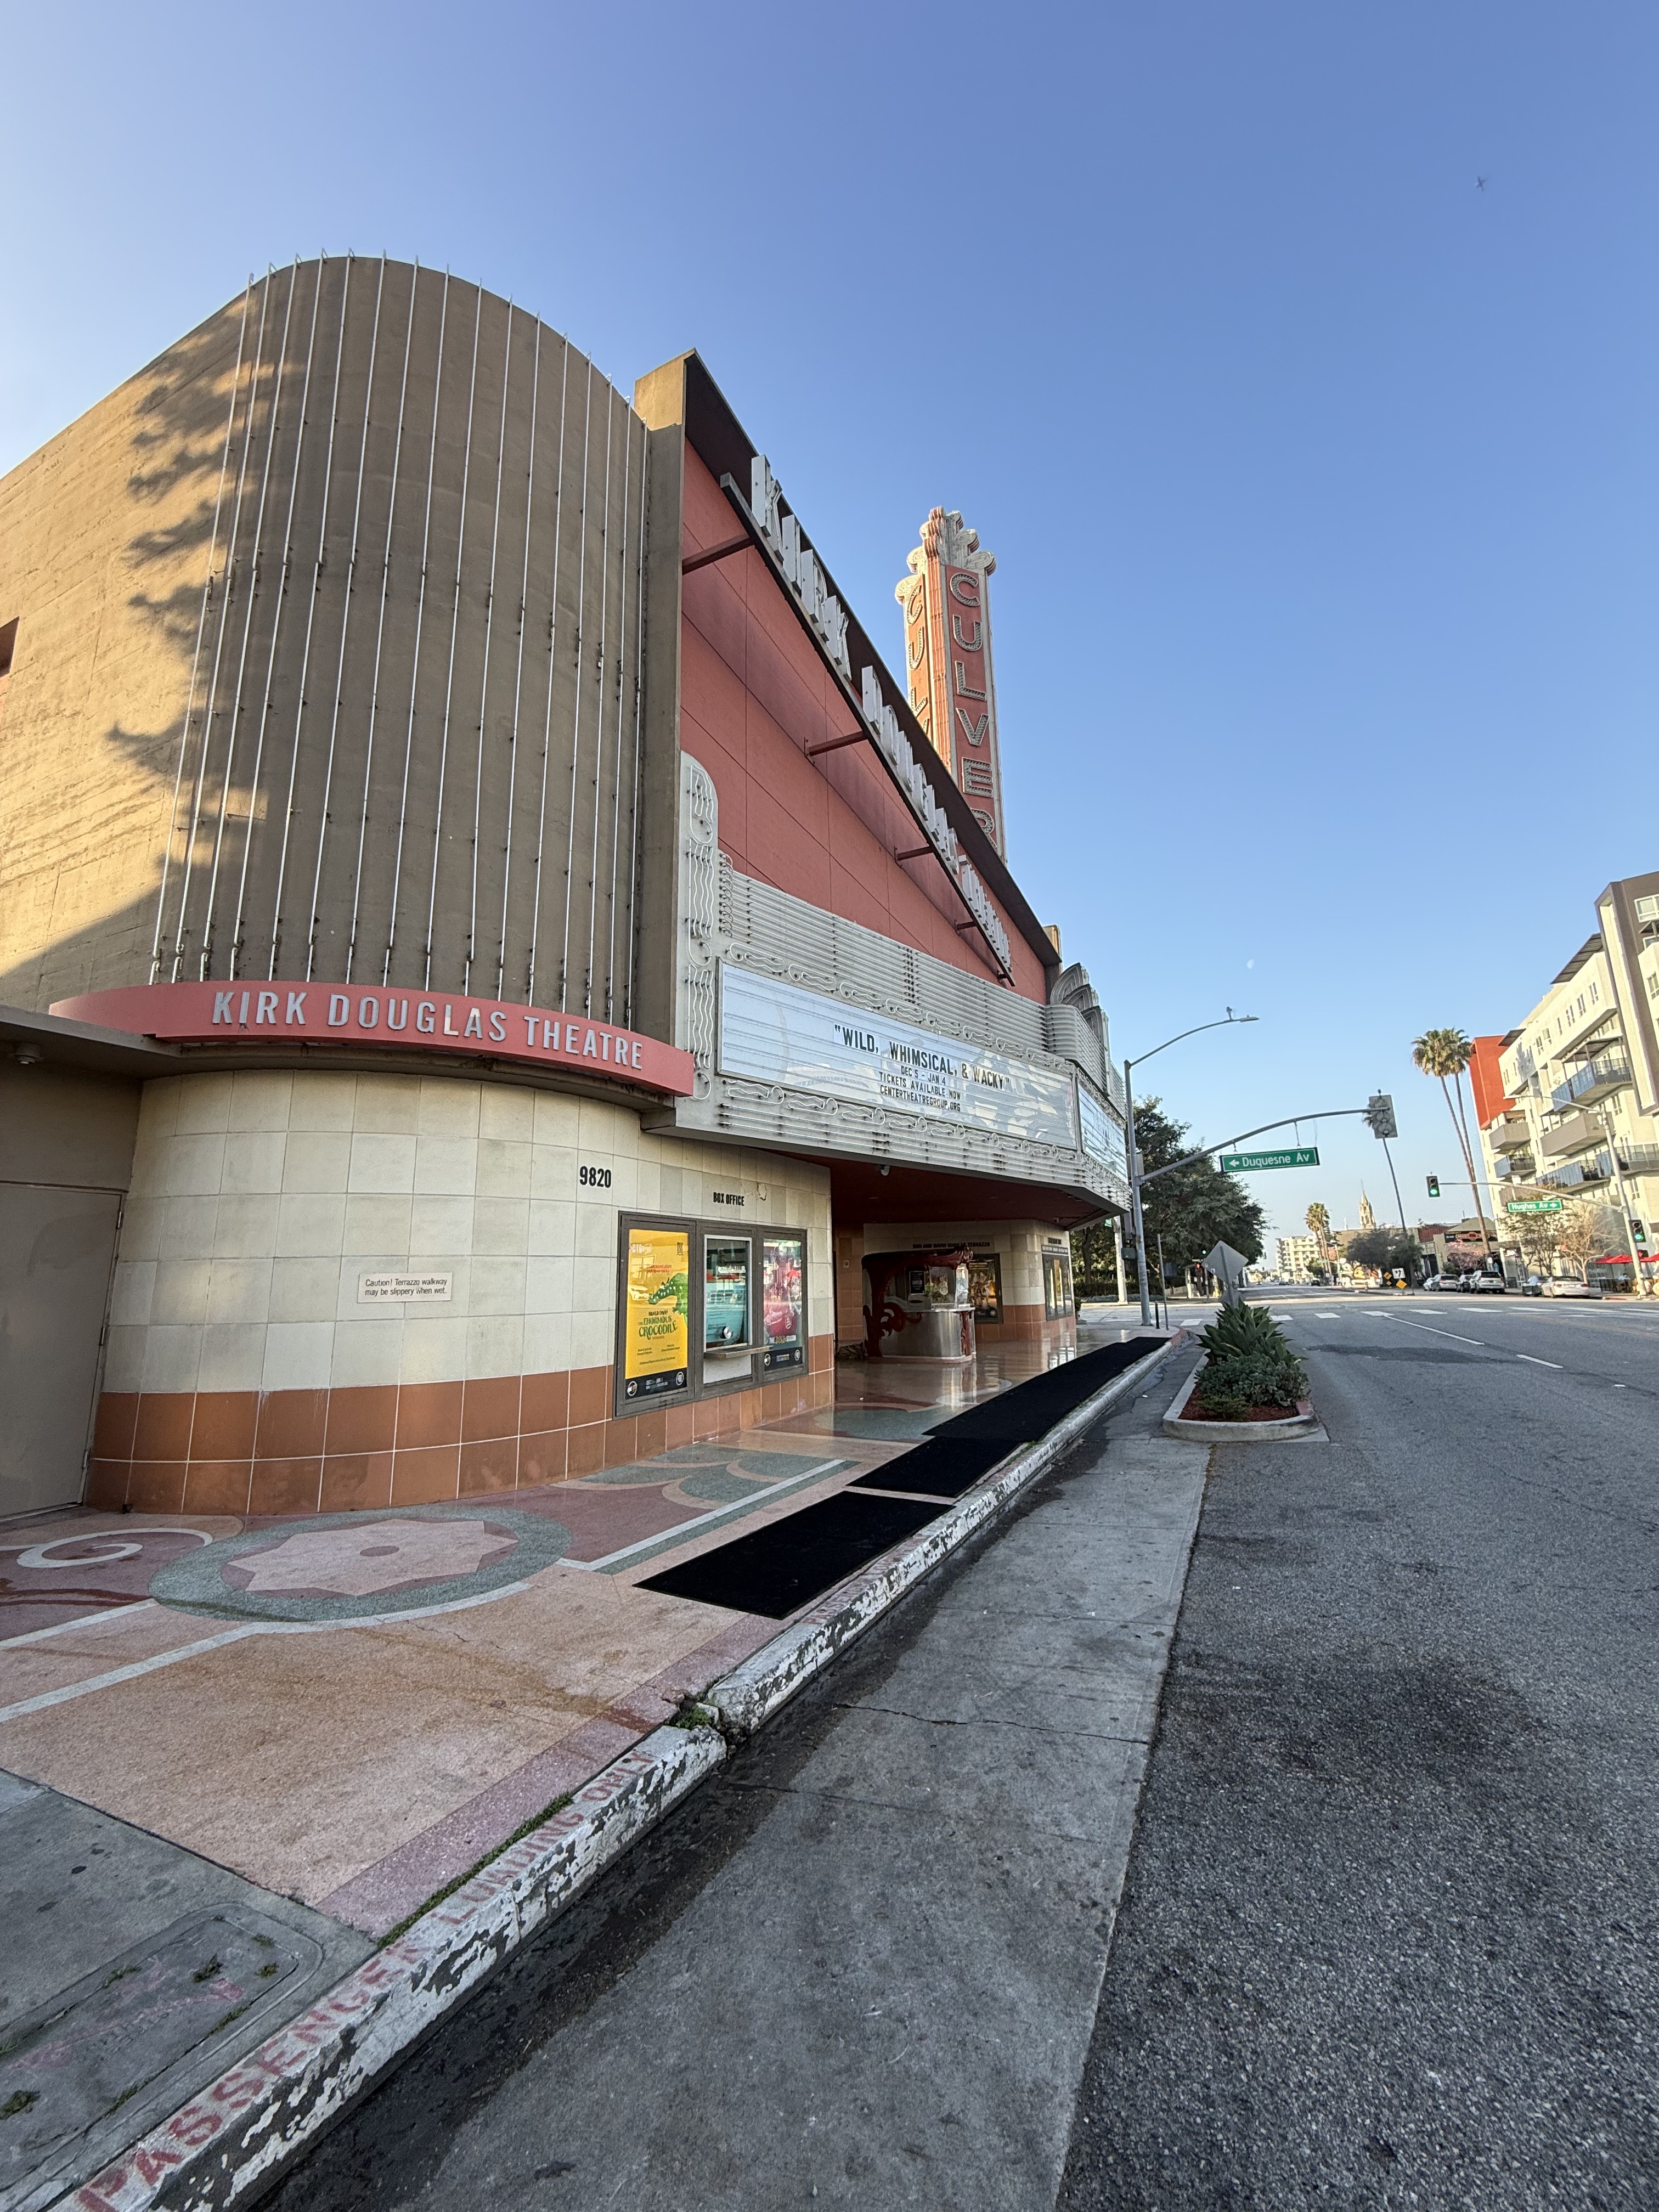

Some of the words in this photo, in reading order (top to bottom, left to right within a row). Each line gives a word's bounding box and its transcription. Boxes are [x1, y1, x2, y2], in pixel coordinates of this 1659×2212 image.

[751, 454, 851, 683] KIRK
[950, 573, 998, 849] CULVER
[212, 991, 307, 1025] KIRK
[329, 994, 507, 1041] DOUGLAS
[523, 1015, 643, 1070] THEATRE
[889, 1041, 957, 1076] WHIMSICAL,
[961, 1063, 969, 1080] &
[879, 1071, 906, 1087] TICKETS
[911, 1081, 945, 1097] AVAILABLE
[949, 1090, 961, 1100] NOW
[901, 1065, 912, 1077] DEC
[915, 1070, 919, 1079] 5
[928, 1073, 939, 1084] JAN
[941, 1077, 946, 1085] 4
[880, 1085, 961, 1111] CENTERTHEATREGROUP.ORG
[1242, 1155, 1291, 1167] Duquesne
[1296, 1153, 1310, 1163] Av
[579, 1166, 611, 1188] 9820
[713, 1192, 724, 1204] BOX
[726, 1194, 744, 1206] OFFICE
[639, 1320, 678, 1340] CROCODILE
[644, 1316, 672, 1325] ENORMOUS
[431, 1810, 584, 1925] LOADING
[582, 1752, 653, 1802] ONLY
